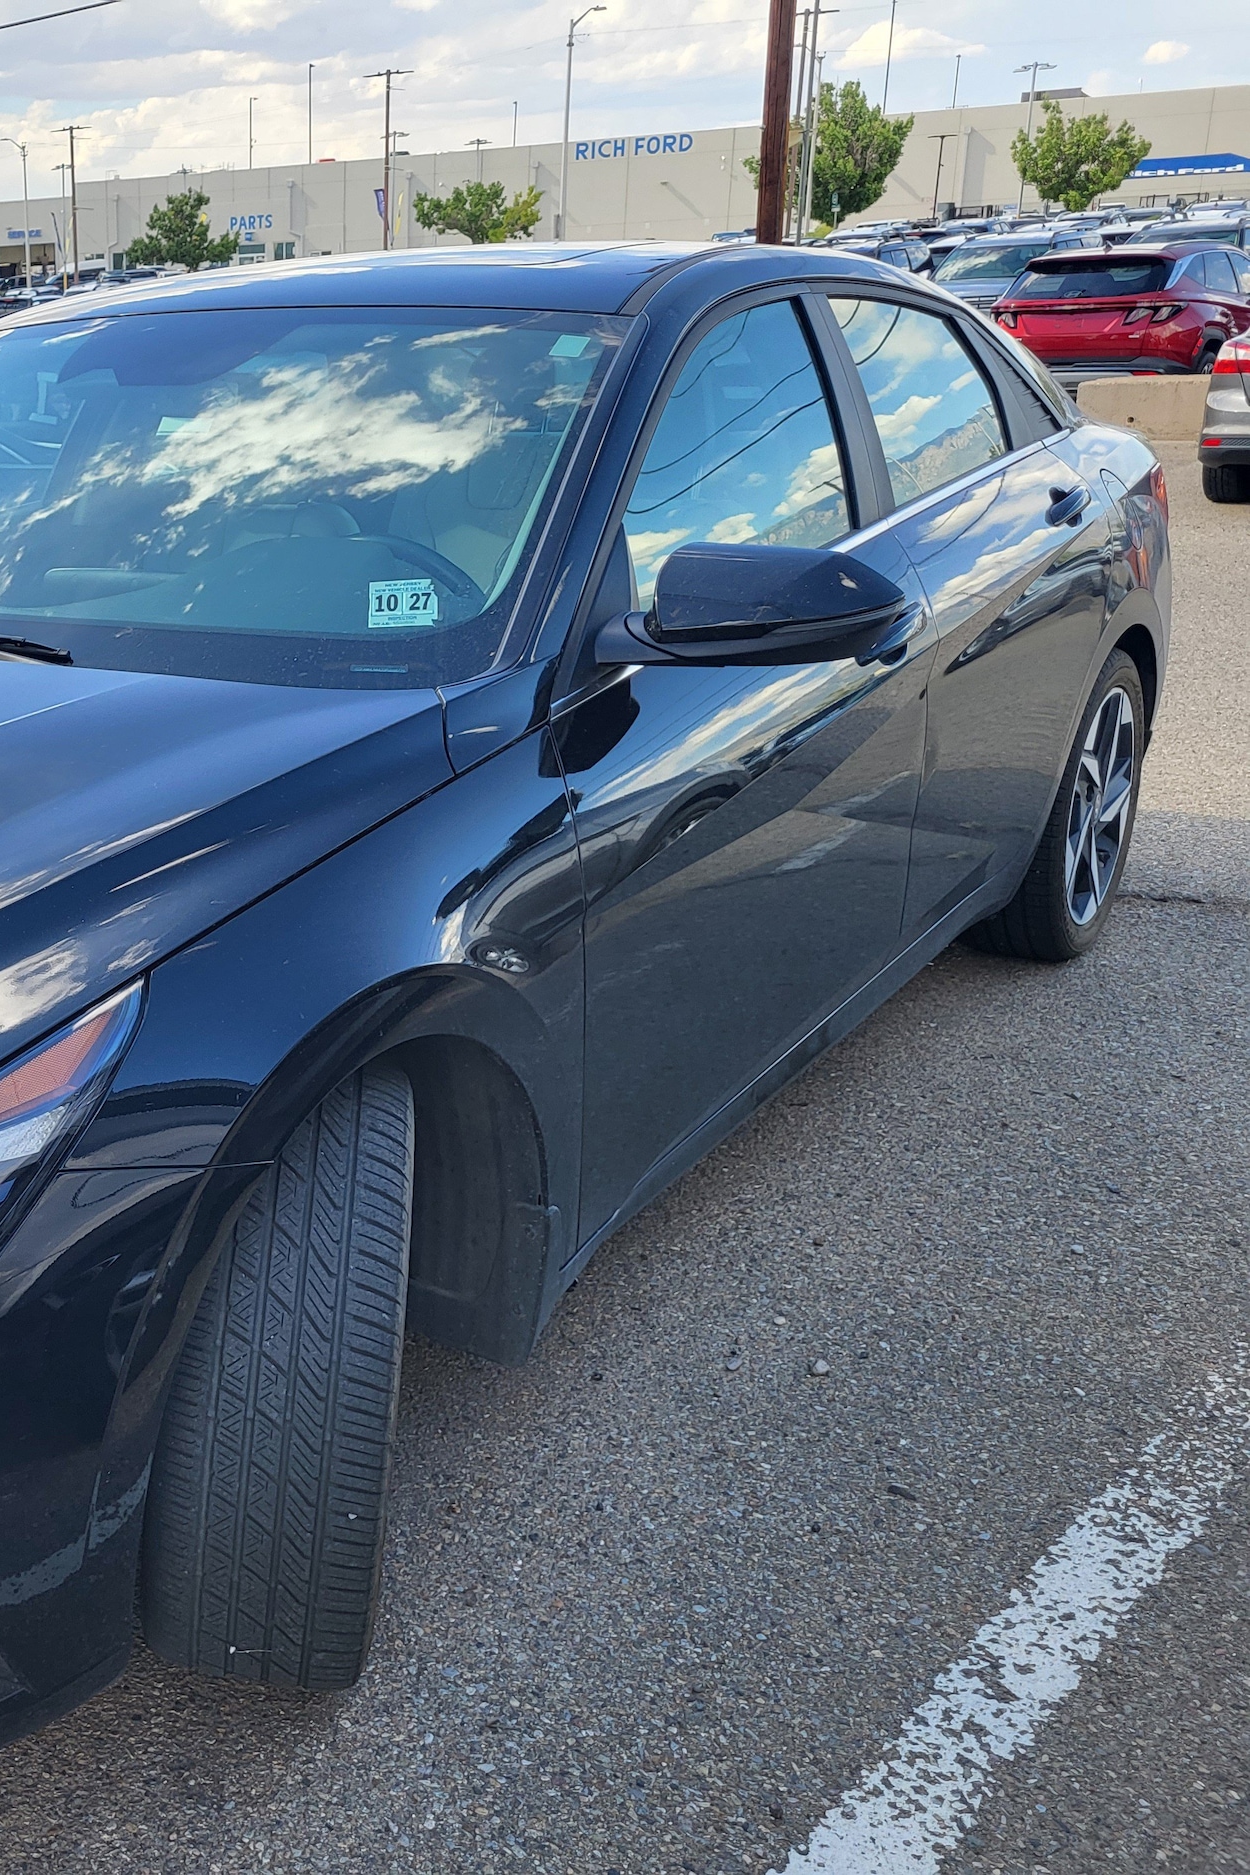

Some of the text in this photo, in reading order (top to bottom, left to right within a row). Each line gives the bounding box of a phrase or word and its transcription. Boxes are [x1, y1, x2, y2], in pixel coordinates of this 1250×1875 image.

[575, 133, 693, 161] RICH FORD
[1177, 164, 1245, 175] Ford
[230, 214, 273, 231] PARTS
[375, 592, 432, 612] 10 27
